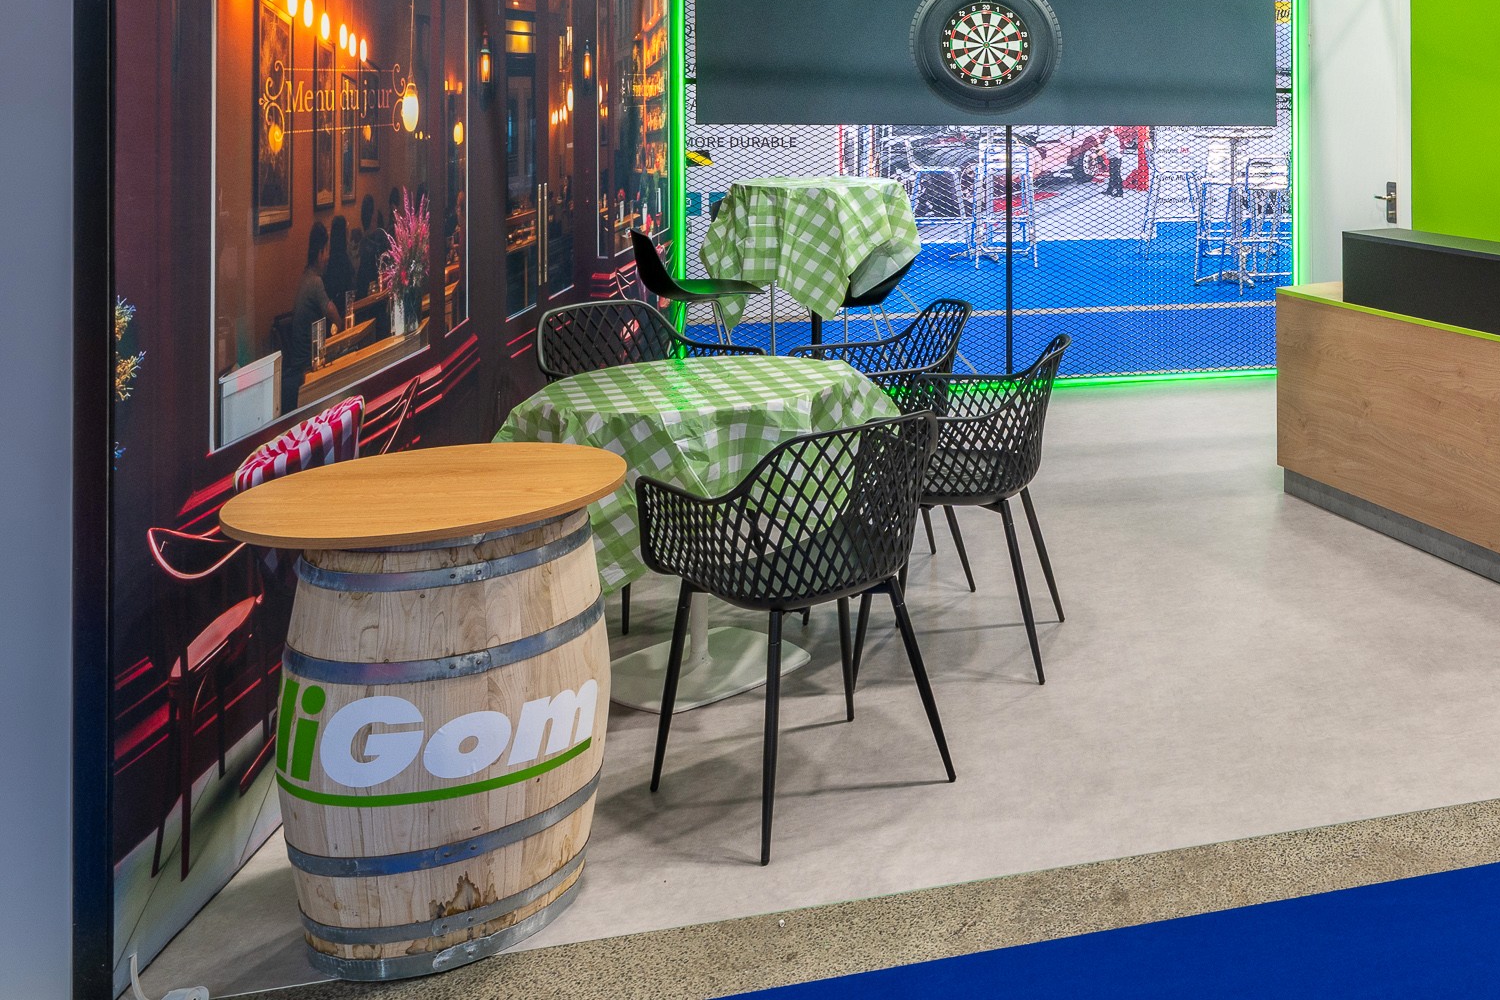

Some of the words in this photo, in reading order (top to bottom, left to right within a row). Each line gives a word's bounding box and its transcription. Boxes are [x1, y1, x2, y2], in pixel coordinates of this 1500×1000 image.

[285, 80, 335, 112] Menu
[339, 79, 360, 111] du
[361, 79, 392, 118] jour
[730, 136, 797, 148] DURABLE
[276, 677, 598, 788] liGom
